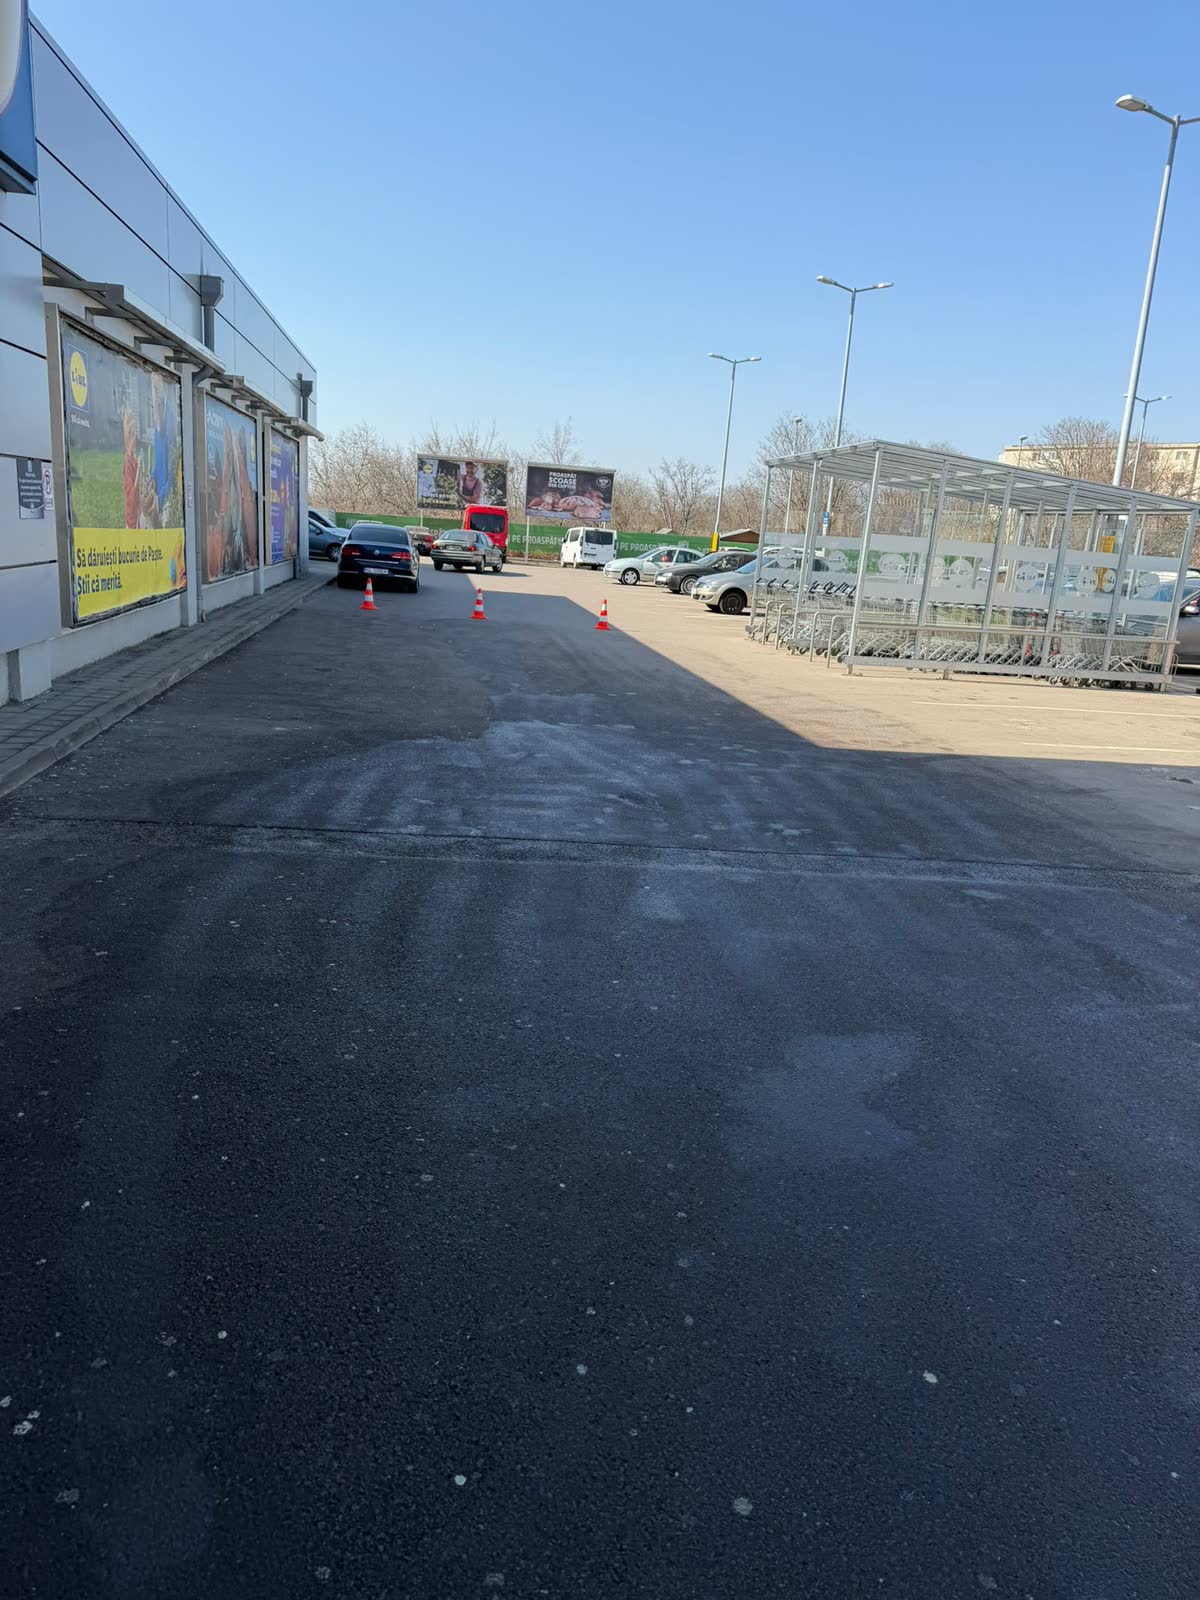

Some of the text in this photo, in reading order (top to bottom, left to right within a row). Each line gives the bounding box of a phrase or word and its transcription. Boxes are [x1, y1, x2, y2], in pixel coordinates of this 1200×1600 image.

[549, 477, 577, 485] SCOASE
[511, 534, 521, 543] PE
[620, 542, 629, 551] PE
[76, 548, 85, 568] Să
[118, 545, 140, 563] bucurie
[141, 545, 148, 562] de
[91, 574, 100, 592] că
[101, 572, 122, 591] merită.
